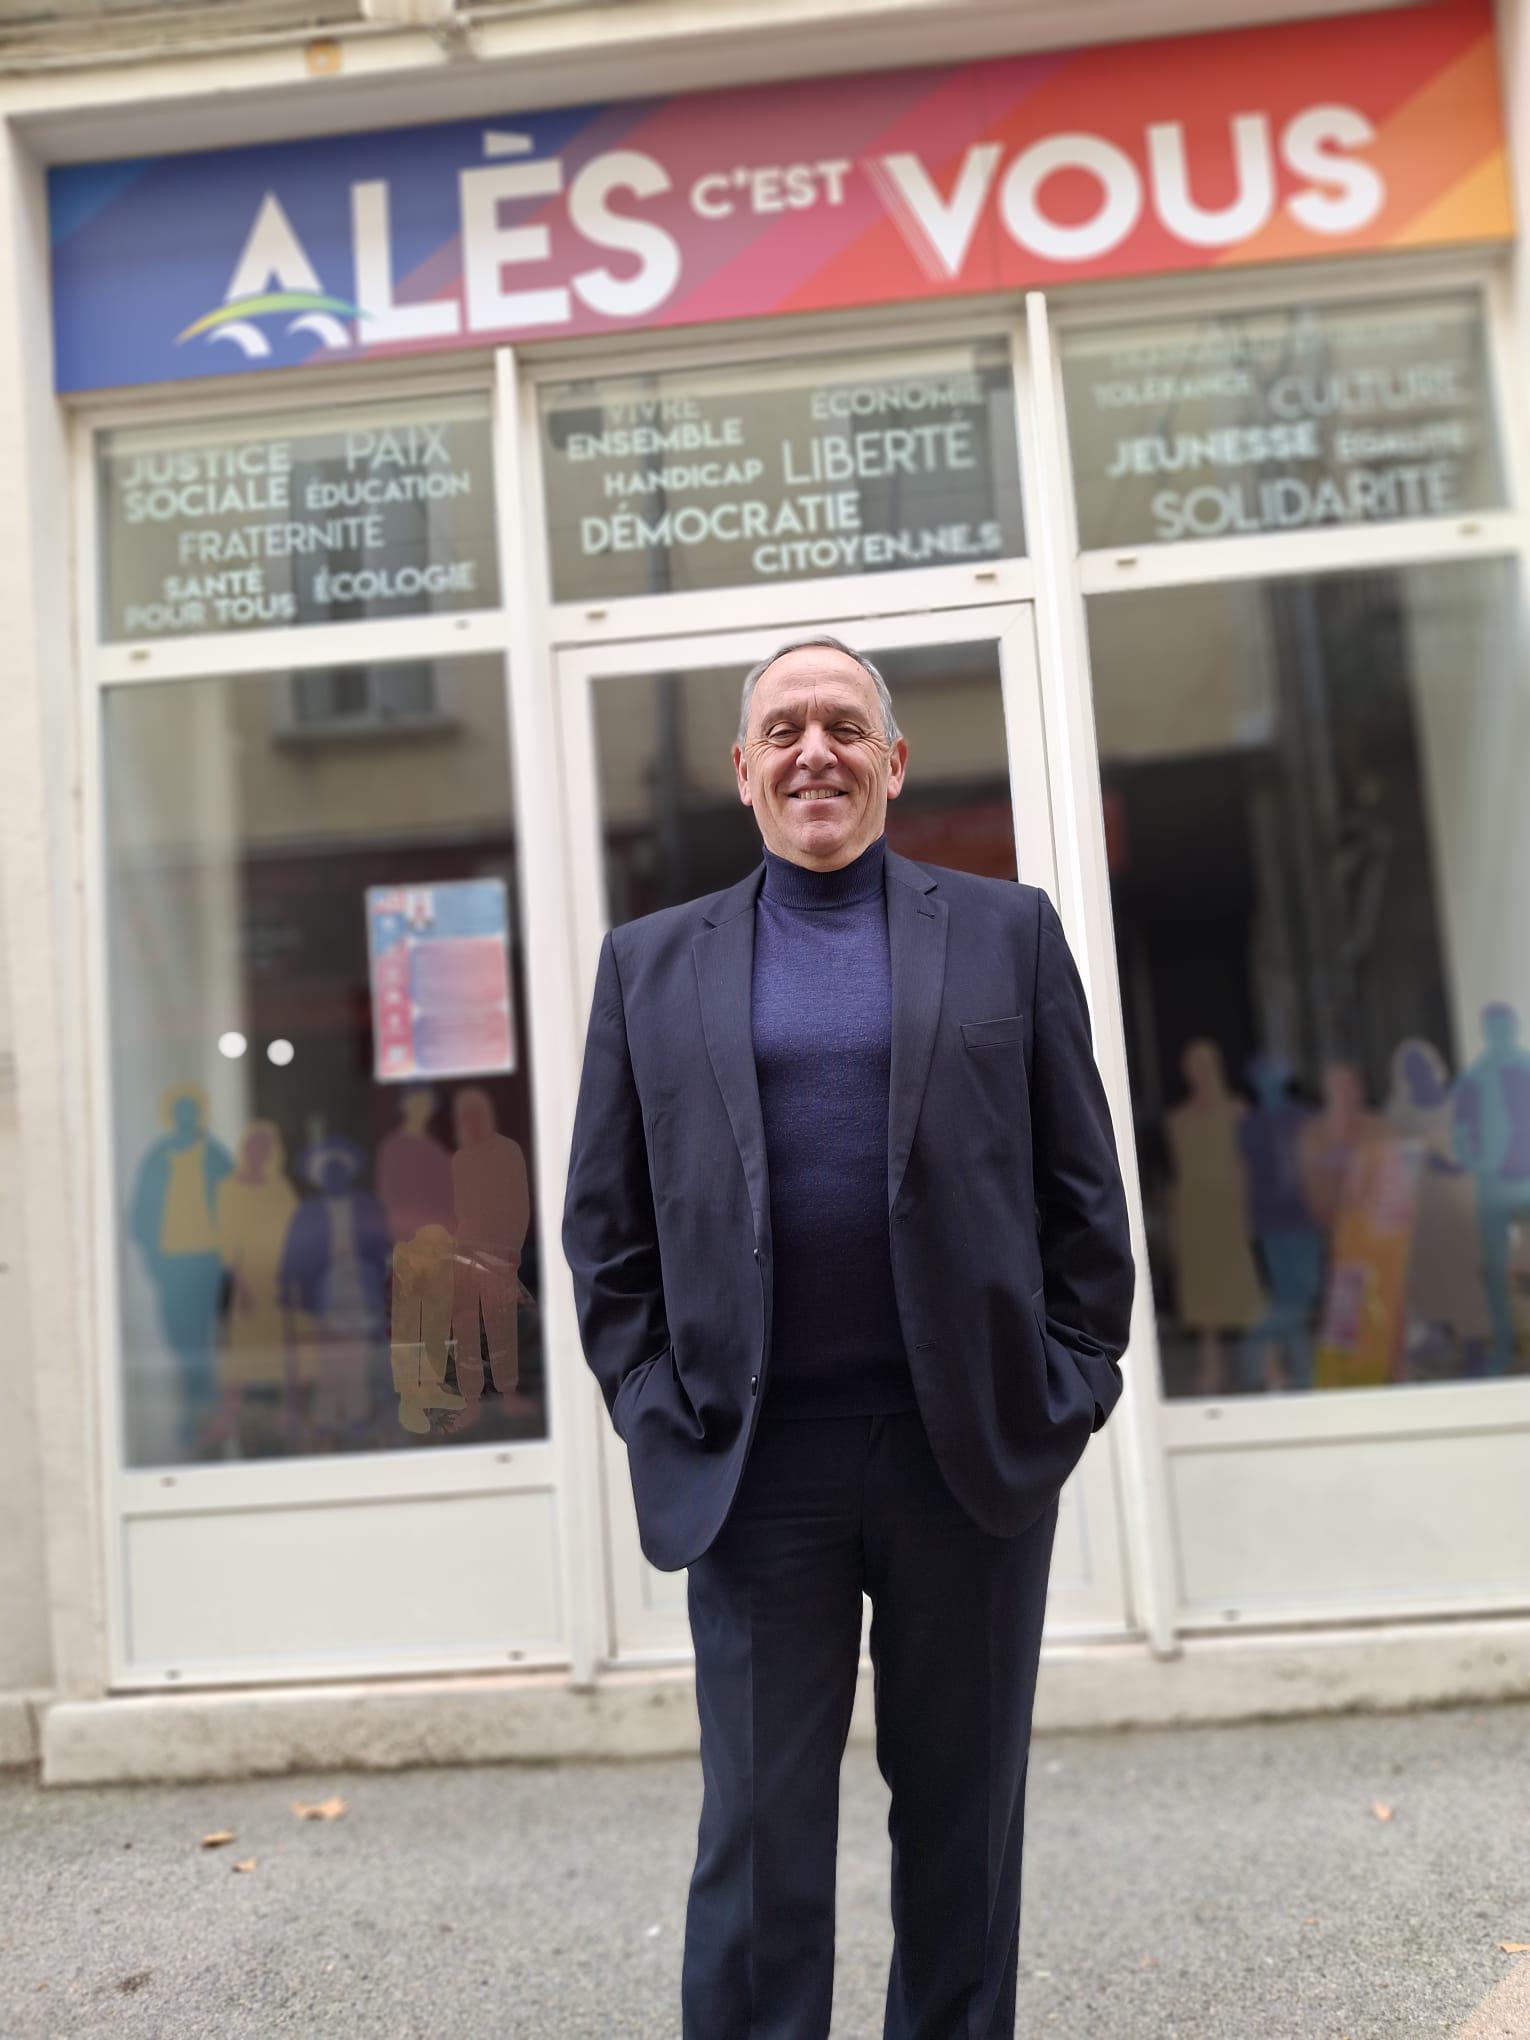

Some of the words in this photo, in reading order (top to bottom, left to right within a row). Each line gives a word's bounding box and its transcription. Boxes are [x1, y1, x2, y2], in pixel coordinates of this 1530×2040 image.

[175, 130, 682, 356] ALÈS
[690, 160, 852, 219] C'EST
[866, 104, 1385, 281] VOUS
[1268, 360, 1464, 421] CULTURE
[344, 422, 452, 471] PAIX
[566, 417, 744, 462] ENSEMBLE
[782, 408, 977, 486] LIBERTÉ
[1104, 421, 1322, 479] JEUNESSE
[122, 440, 292, 489] JUSTICE
[603, 458, 765, 498] HANDICAP
[124, 476, 290, 524] SOCIALE
[304, 470, 471, 510] ÉDUCATION
[178, 506, 385, 566] FRATERNITÉ
[580, 490, 862, 556] DÉMOCRATIE
[163, 563, 264, 602] SANTÉ
[313, 560, 477, 605] ÉCOLOGIE
[123, 601, 207, 631] POUR
[214, 592, 297, 624] TOUS
